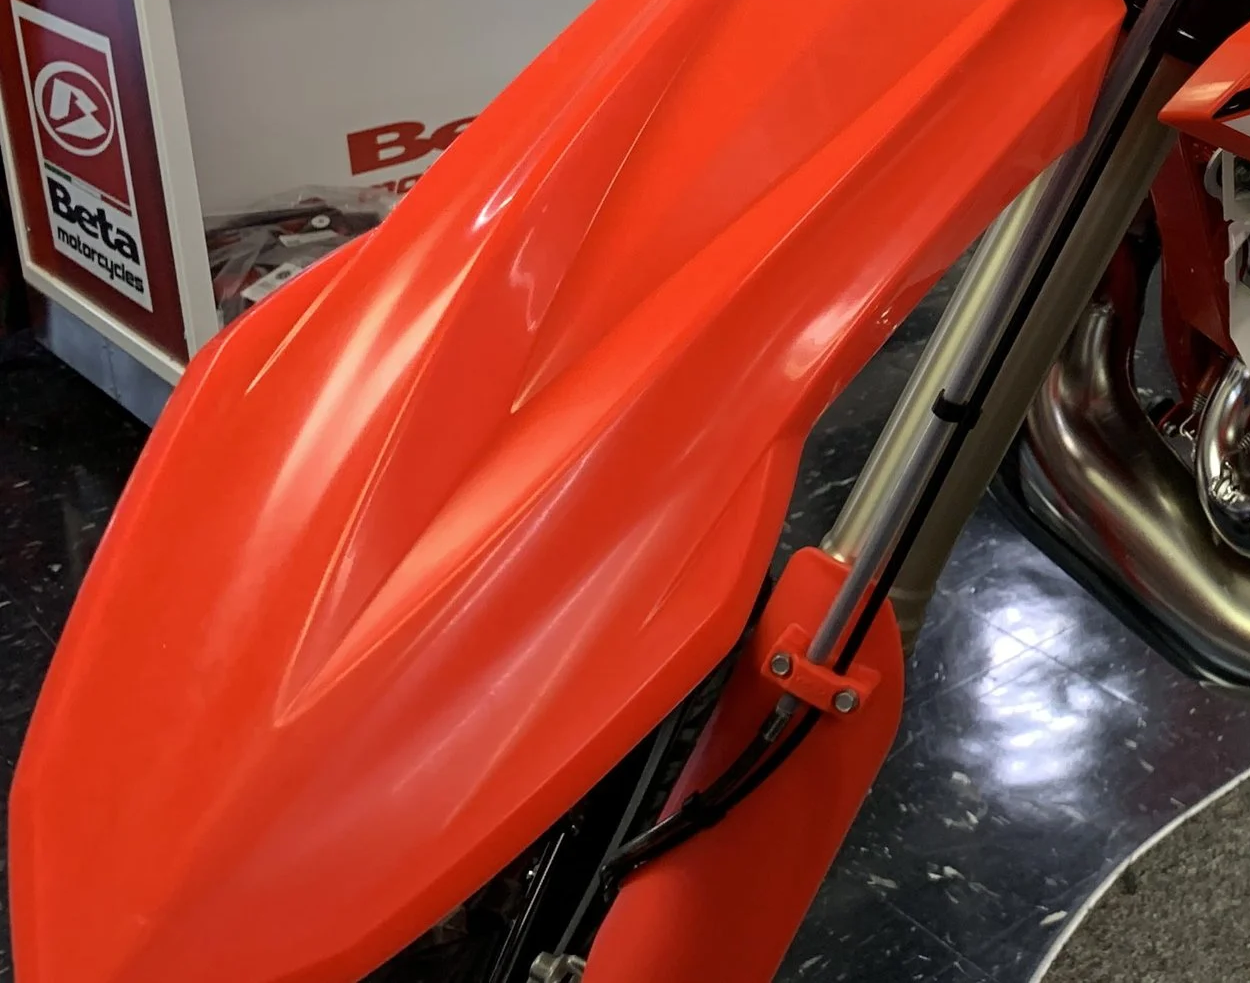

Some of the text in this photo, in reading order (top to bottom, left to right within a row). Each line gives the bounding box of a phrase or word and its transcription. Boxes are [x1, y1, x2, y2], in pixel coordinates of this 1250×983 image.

[347, 115, 479, 176] Be
[47, 176, 140, 267] Beta
[57, 226, 145, 295] motorcycles
